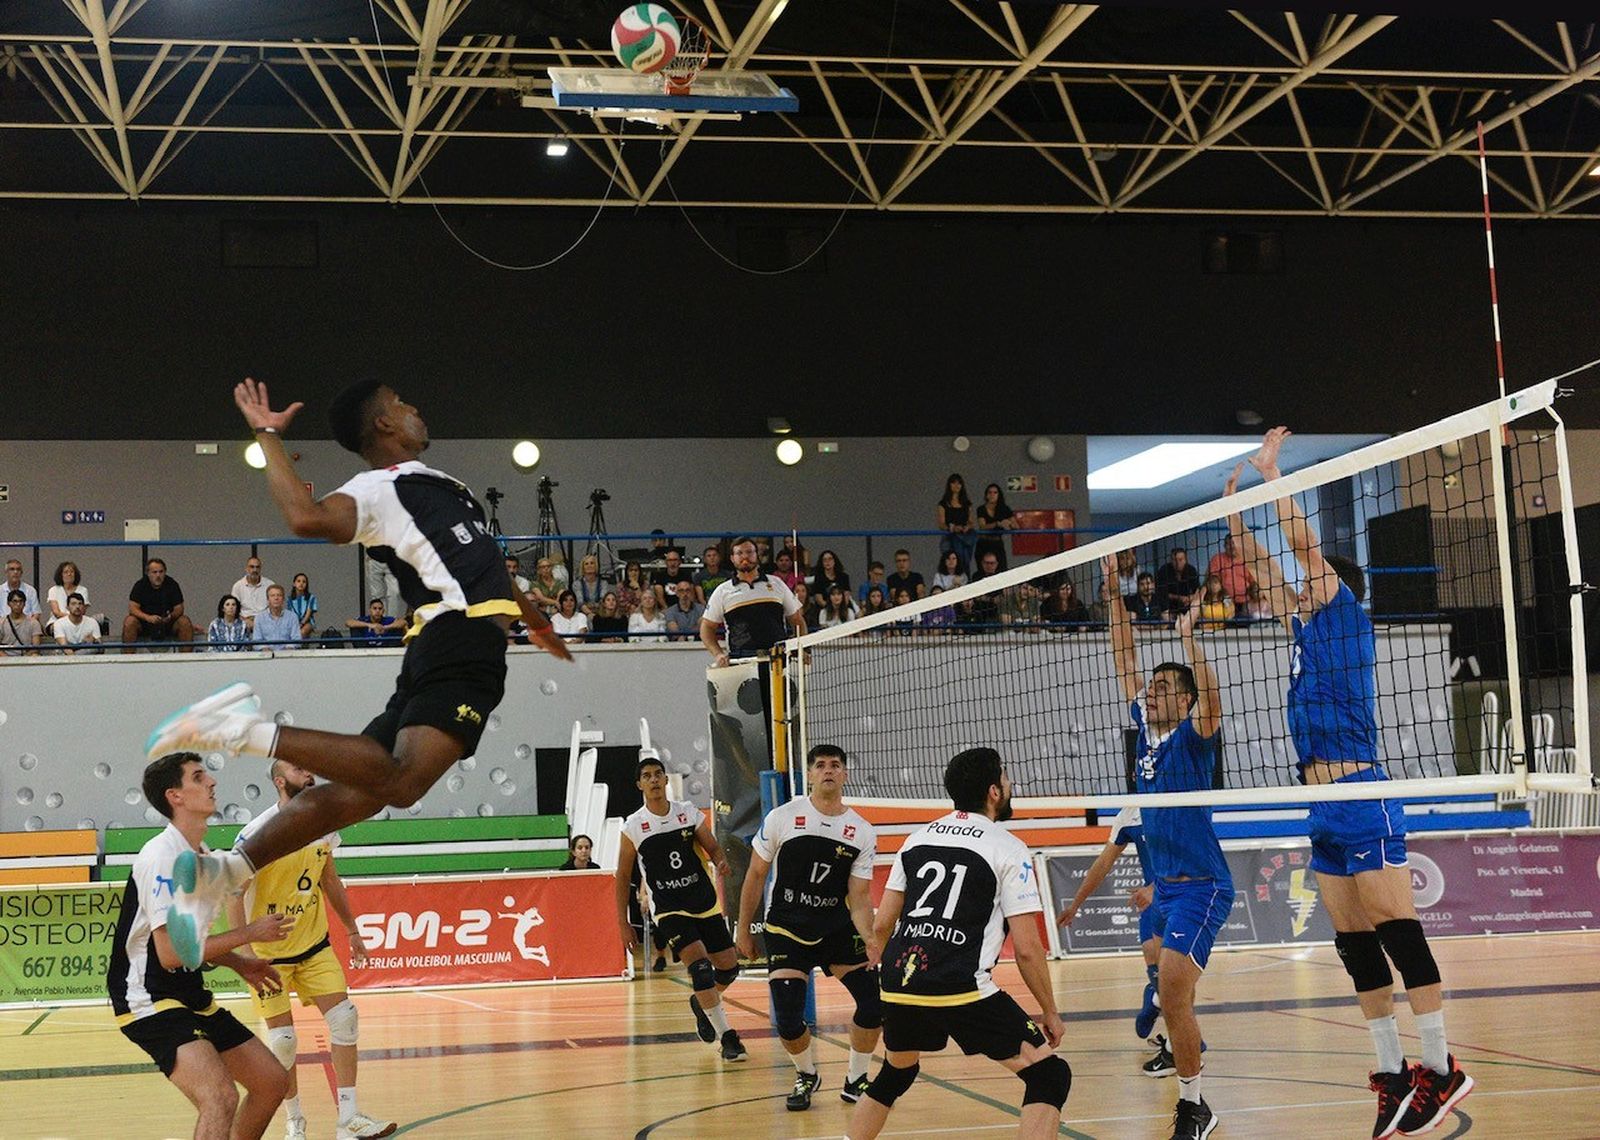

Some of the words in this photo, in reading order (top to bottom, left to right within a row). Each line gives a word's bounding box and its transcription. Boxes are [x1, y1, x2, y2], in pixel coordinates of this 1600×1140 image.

[926, 822, 984, 839] Parada
[1487, 844, 1518, 855] Angelo
[669, 851, 682, 869] 8
[297, 869, 312, 891] 6
[809, 862, 832, 884] 17
[1071, 867, 1143, 878] MOAJES
[1255, 852, 1313, 902] MAFE
[1498, 867, 1509, 876] de
[665, 873, 699, 889] MADRID
[800, 892, 838, 907] MADRID
[908, 861, 968, 920] 21
[1510, 887, 1543, 897] Madrid
[0, 892, 123, 918] ISIOTERA
[354, 909, 492, 950] SM-2
[903, 922, 967, 946] MADRID
[23, 957, 56, 978] 667
[60, 955, 93, 977] 894
[97, 954, 111, 976] 3
[349, 957, 403, 969] SPERLIGA
[405, 955, 452, 968] VOLEIBOL
[454, 951, 512, 966] MASCULINA
[13, 986, 43, 996] Avenida
[44, 985, 64, 995] Pablo
[66, 983, 93, 995] Neruda
